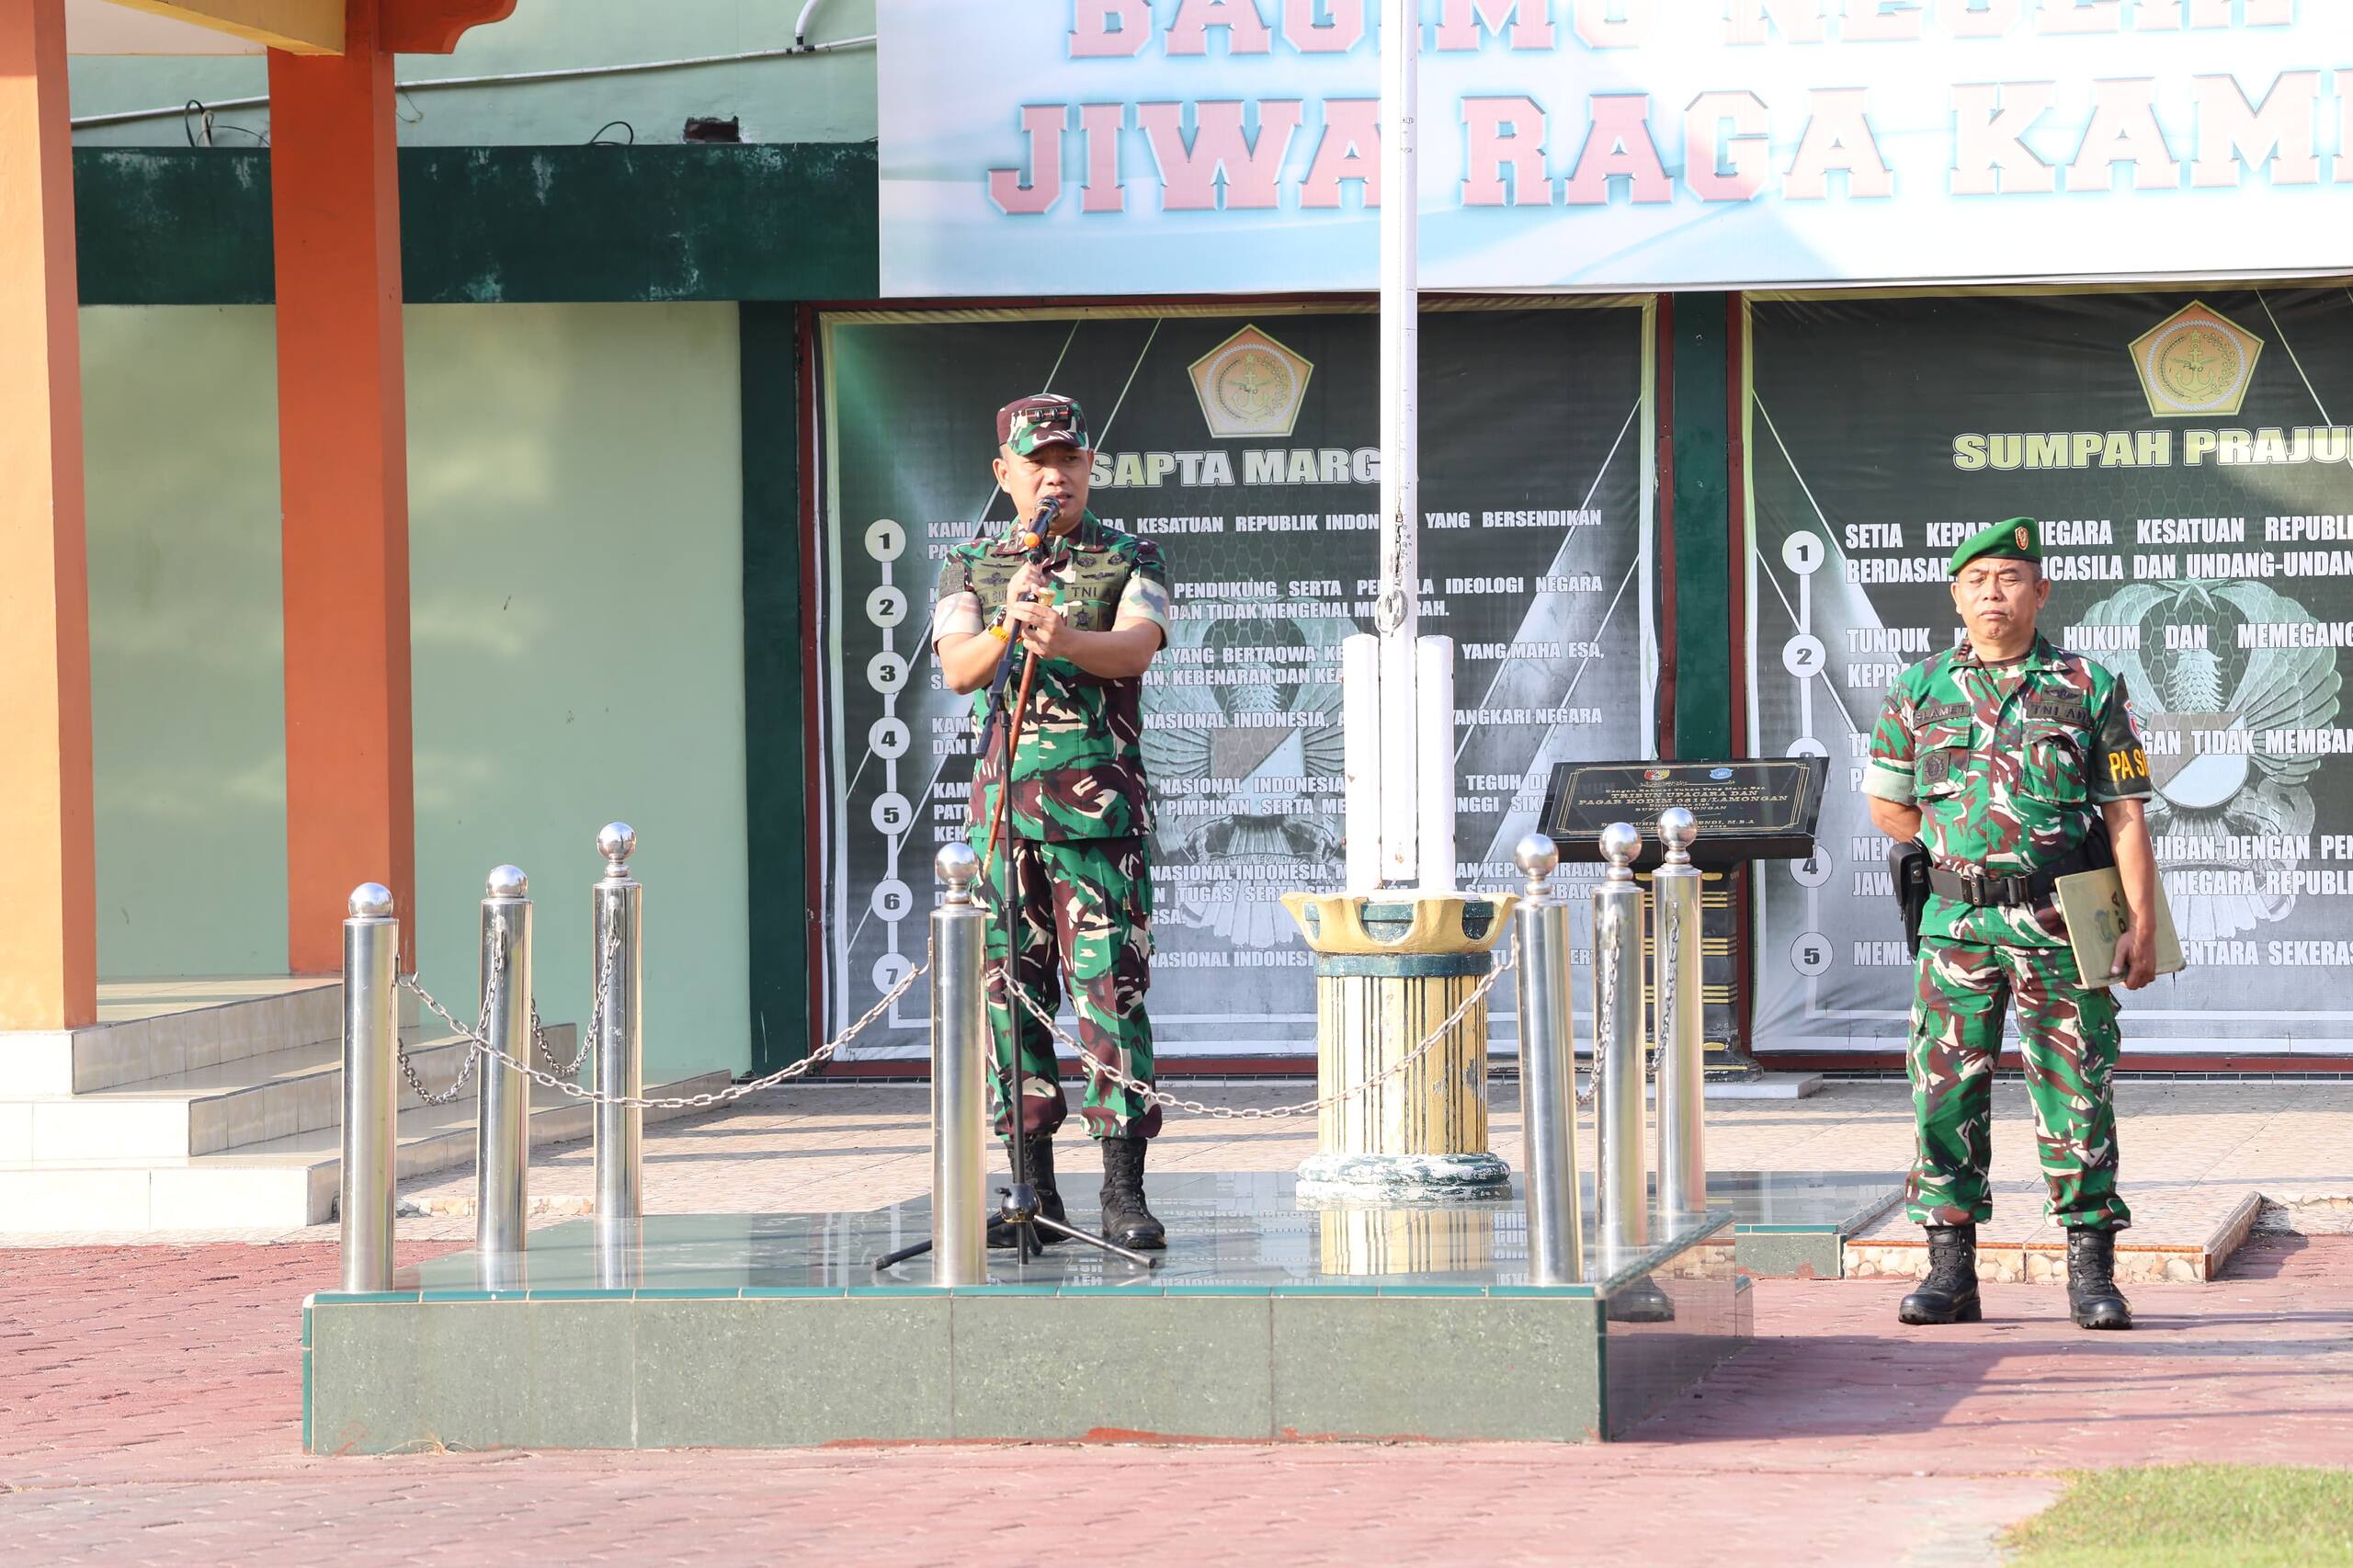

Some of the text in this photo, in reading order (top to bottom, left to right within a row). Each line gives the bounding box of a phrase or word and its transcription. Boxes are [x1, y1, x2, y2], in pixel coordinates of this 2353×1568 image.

[989, 97, 1381, 215] JIWA
[1460, 87, 1893, 207] RAGA
[1953, 426, 2353, 471] SUMPAH PRAJU
[1088, 448, 1381, 489] SAPTA MARG
[927, 521, 972, 539] KAMI
[1137, 517, 1223, 534] KESATUAN
[1235, 515, 1318, 532] REPUBLIK
[1325, 514, 1381, 530] INDON
[1425, 512, 1471, 529] YANG
[1482, 509, 1602, 528] BERSENDIKAN
[1845, 523, 1904, 549] SETIA
[1927, 521, 1996, 548] KEPA
[2136, 517, 2245, 544] KESATUAN
[879, 532, 891, 550] 1
[1796, 544, 1809, 562] 1
[1846, 558, 1958, 584] BERDASAR
[2041, 555, 2124, 581] NCASILA
[2132, 554, 2177, 580] DAN
[1071, 585, 1097, 598] TNI
[1174, 581, 1279, 598] PENDUKUNG
[1289, 580, 1342, 597] SERTA
[1446, 577, 1524, 595] IDEOLOGI
[1535, 575, 1603, 593] NEGARA
[879, 599, 894, 616] 2
[1168, 604, 1201, 620] DAN
[1207, 603, 1257, 619] TIDAK
[1262, 601, 1350, 619] MENGENAL
[1846, 628, 1931, 653] TUNDUK
[2063, 625, 2141, 651] HUKUM
[2165, 625, 2208, 650] DAN
[1171, 647, 1214, 664] YANG
[1222, 646, 1316, 664] BERTAQWA
[1462, 644, 1506, 660] YANG
[1510, 642, 1562, 659] MAHA
[1568, 642, 1605, 660] ESA,
[1796, 648, 1813, 665] 2
[880, 665, 895, 682] 3
[1173, 669, 1271, 687] KEBENARAN
[1275, 669, 1311, 686] DAN
[2030, 703, 2059, 716] TNI
[932, 717, 972, 733] KAM
[1143, 712, 1227, 730] NASIONAL
[1233, 711, 1331, 730] INDONESIA,
[1453, 708, 1531, 725] ANGKARI
[1535, 707, 1603, 725] NEGARA
[881, 731, 897, 747] 4
[932, 739, 966, 755] DAN
[2191, 730, 2256, 755] TIDAK
[2109, 750, 2135, 782] PA
[934, 782, 972, 798] KAM
[1160, 778, 1243, 794] NASIONAL
[1465, 775, 1521, 791] TEGUH
[883, 807, 900, 824] 5
[1166, 799, 1251, 816] PIMPINAN
[1261, 799, 1314, 815] SERTA
[2225, 835, 2311, 860] DENGAN
[1151, 865, 1233, 881] NASIONAL
[1236, 864, 1332, 882] INDONESIA,
[1802, 858, 1819, 875] 4
[2174, 870, 2257, 896] NEGARA
[883, 893, 900, 910] 6
[1177, 887, 1233, 903] TUGAS
[1149, 951, 1313, 968] NASIONAL INDONESI
[1804, 948, 1820, 965] 5
[2182, 940, 2259, 965] ENTARA
[885, 968, 899, 984] 7
